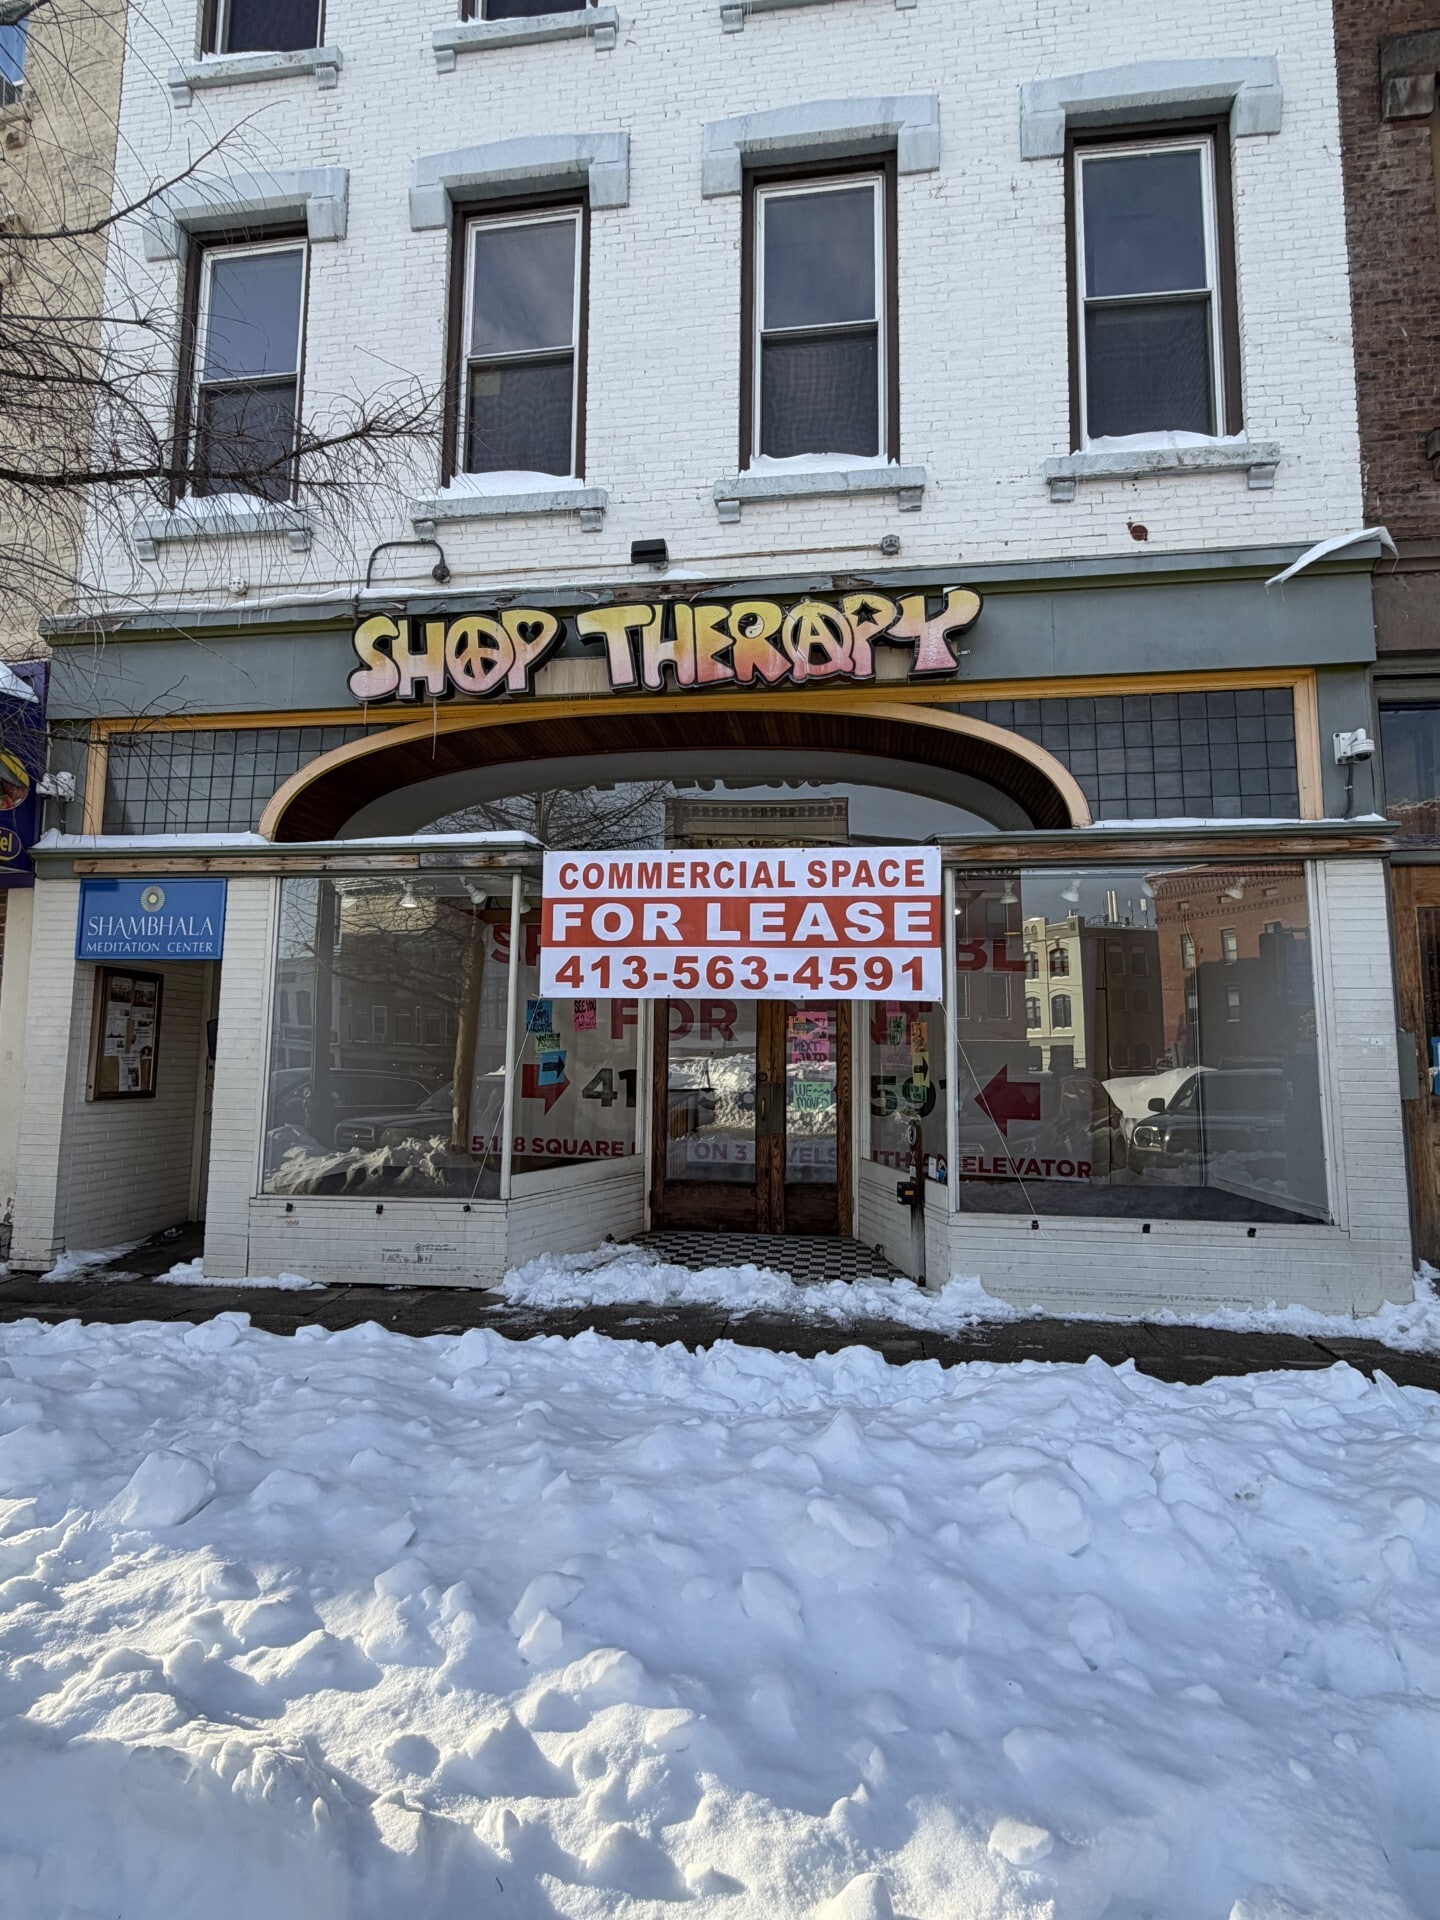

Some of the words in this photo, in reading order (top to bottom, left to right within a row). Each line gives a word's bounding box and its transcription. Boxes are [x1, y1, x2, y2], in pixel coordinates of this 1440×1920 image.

[348, 605, 567, 701] SHOP
[574, 585, 984, 694] THERAPY
[0, 832, 13, 852] el
[559, 861, 796, 890] COMMERCIAL
[807, 859, 925, 888] SPACE
[88, 916, 214, 940] SHAMBHALA
[552, 902, 683, 942] FOR
[706, 901, 932, 942] LEASE
[86, 941, 160, 953] MEDITATION
[167, 941, 213, 953] CENTER
[555, 955, 923, 991] 413-563-4591
[532, 1138, 625, 1157] SQUARE
[694, 1143, 728, 1161] ON
[733, 1144, 748, 1161] 3
[962, 1156, 1092, 1178] ELEVATOR
